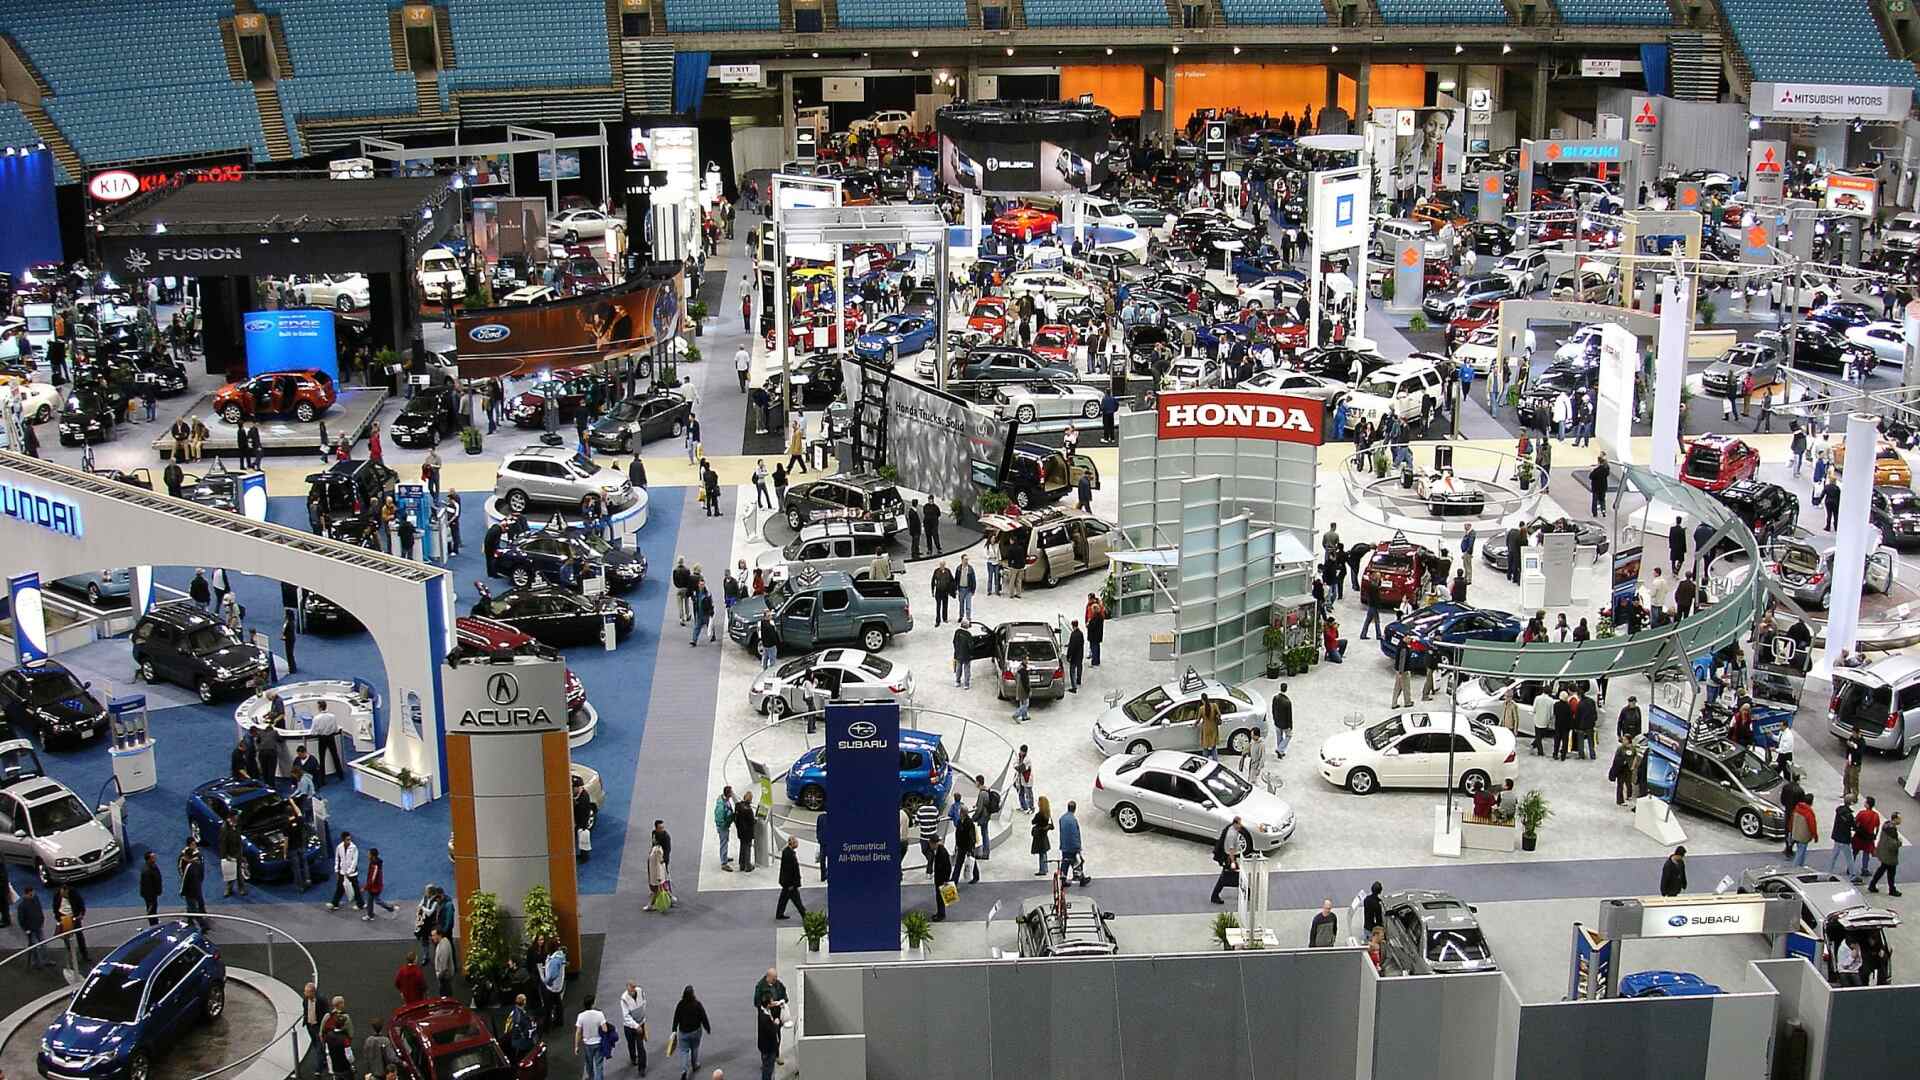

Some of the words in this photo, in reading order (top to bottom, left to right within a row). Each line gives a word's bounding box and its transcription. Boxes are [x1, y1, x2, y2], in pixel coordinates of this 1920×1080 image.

[411, 8, 426, 20] 37
[242, 18, 259, 29] 36
[1794, 93, 1844, 105] MITSUBISHI
[1847, 96, 1882, 106] MOTORS
[1562, 146, 1620, 158] SUZUKI
[998, 161, 1034, 169] BUICK
[100, 177, 132, 194] KIA
[139, 173, 168, 193] KIA
[157, 247, 242, 261] FUSION
[478, 325, 503, 339] Ford
[895, 402, 918, 417] Honda
[946, 416, 965, 432] Solid
[1165, 403, 1315, 433] HONDA
[459, 706, 553, 727] ACURA
[838, 740, 888, 749] SUBARU
[842, 842, 887, 853] Symmetrical
[838, 853, 872, 863] All-Wheel
[872, 852, 892, 862] Drive
[1691, 915, 1740, 925] SUBARU
